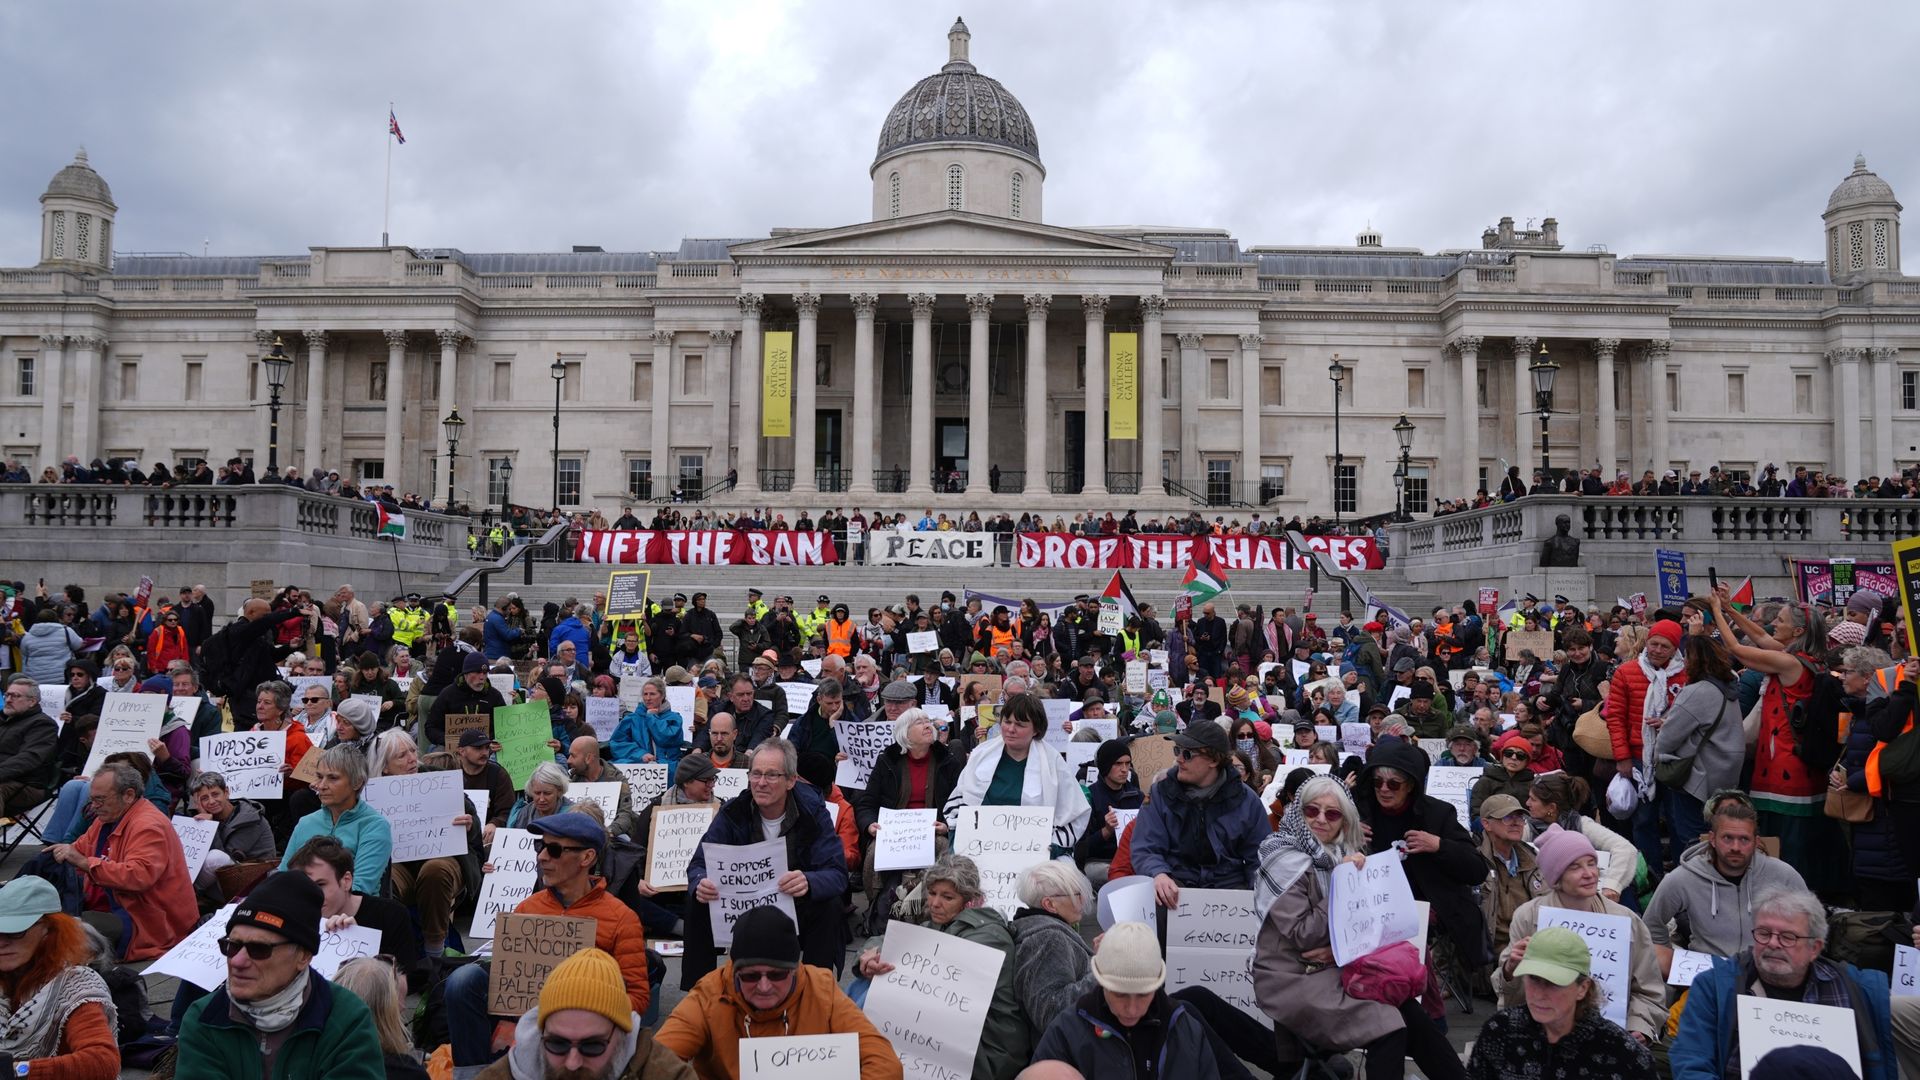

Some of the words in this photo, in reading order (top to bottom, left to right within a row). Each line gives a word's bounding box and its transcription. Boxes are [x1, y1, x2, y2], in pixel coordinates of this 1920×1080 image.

[831, 268, 866, 280] THE
[879, 268, 975, 280] NATIONAL
[987, 268, 1073, 280] GALLERY
[770, 348, 779, 398] NATIONAL
[778, 348, 788, 398] GALLERY
[1116, 351, 1124, 400] NATIONAL
[1125, 351, 1133, 400] GALLERY
[581, 531, 655, 564] LIFT
[666, 532, 734, 565] THE
[747, 531, 825, 566] BAN
[886, 536, 983, 560] PEACE
[1018, 533, 1118, 569] DROP
[1128, 536, 1193, 569] THE
[1810, 580, 1832, 596] LON
[1859, 577, 1895, 597] REGION
[118, 701, 152, 713] OPPOSE
[455, 716, 483, 726] OPPOSE
[839, 722, 844, 734] I
[847, 724, 895, 737] OPPOS
[214, 737, 270, 756] OPPOSE
[515, 744, 545, 757] SUPPOR
[847, 737, 894, 748] GENOCI
[221, 755, 276, 768] GENOCIDE
[848, 747, 884, 759] SUPP
[625, 768, 666, 780] OPPOSE
[714, 776, 740, 788] POSE
[1446, 771, 1469, 779] OPPO
[247, 774, 283, 792] ACTION
[388, 776, 452, 797] OPPOSE
[628, 783, 667, 794] ENOCIDE
[375, 803, 423, 817] NOCIDE
[666, 811, 708, 825] OPPOSE
[393, 816, 434, 830] PPORT
[974, 810, 979, 830] I
[177, 825, 210, 844] OPPOSE
[391, 827, 449, 845] ESTINE
[657, 827, 705, 839] GENOCIDE
[882, 834, 928, 844] PALESTINE
[893, 827, 929, 836] SUPPORT
[502, 835, 508, 849] I
[889, 844, 921, 853] ACTION
[392, 842, 443, 860] CTION
[656, 849, 693, 860] SUPPOR
[492, 857, 539, 873] GENO
[655, 860, 688, 870] PALEST
[717, 861, 725, 871] I
[730, 857, 773, 872] OPPOSE
[661, 871, 688, 881] ACTI
[719, 869, 776, 886] GENOCIDE
[982, 870, 1018, 885] supp
[489, 883, 495, 898] I
[501, 885, 534, 898] SUPP
[721, 897, 727, 909] I
[730, 893, 779, 911] SUPPORT
[1178, 903, 1192, 917] I
[501, 916, 510, 936] I
[520, 918, 585, 940] OPPOSE
[1559, 920, 1617, 939] OPPOSE
[319, 930, 369, 958] PPOSE
[501, 936, 584, 958] GENOCIDE
[933, 943, 940, 957] I
[174, 948, 226, 971] ACTION
[901, 952, 963, 982] OPPOSE
[499, 959, 507, 977] I
[513, 960, 553, 978] SUPP
[1175, 967, 1186, 985] I
[1199, 969, 1254, 984] SUPPOR
[498, 977, 545, 995] PALES
[887, 970, 971, 1013] GENOCIDE
[494, 993, 539, 1011] ACTIO
[915, 1010, 921, 1023] I
[1753, 1007, 1763, 1020] I
[1774, 1010, 1821, 1026] OPPOSE
[881, 1021, 944, 1053] SUPPORT
[1768, 1025, 1823, 1042] Genocide
[754, 1049, 758, 1073] I
[771, 1045, 841, 1067] OPPOSE
[900, 1052, 961, 1080] ESTINE
